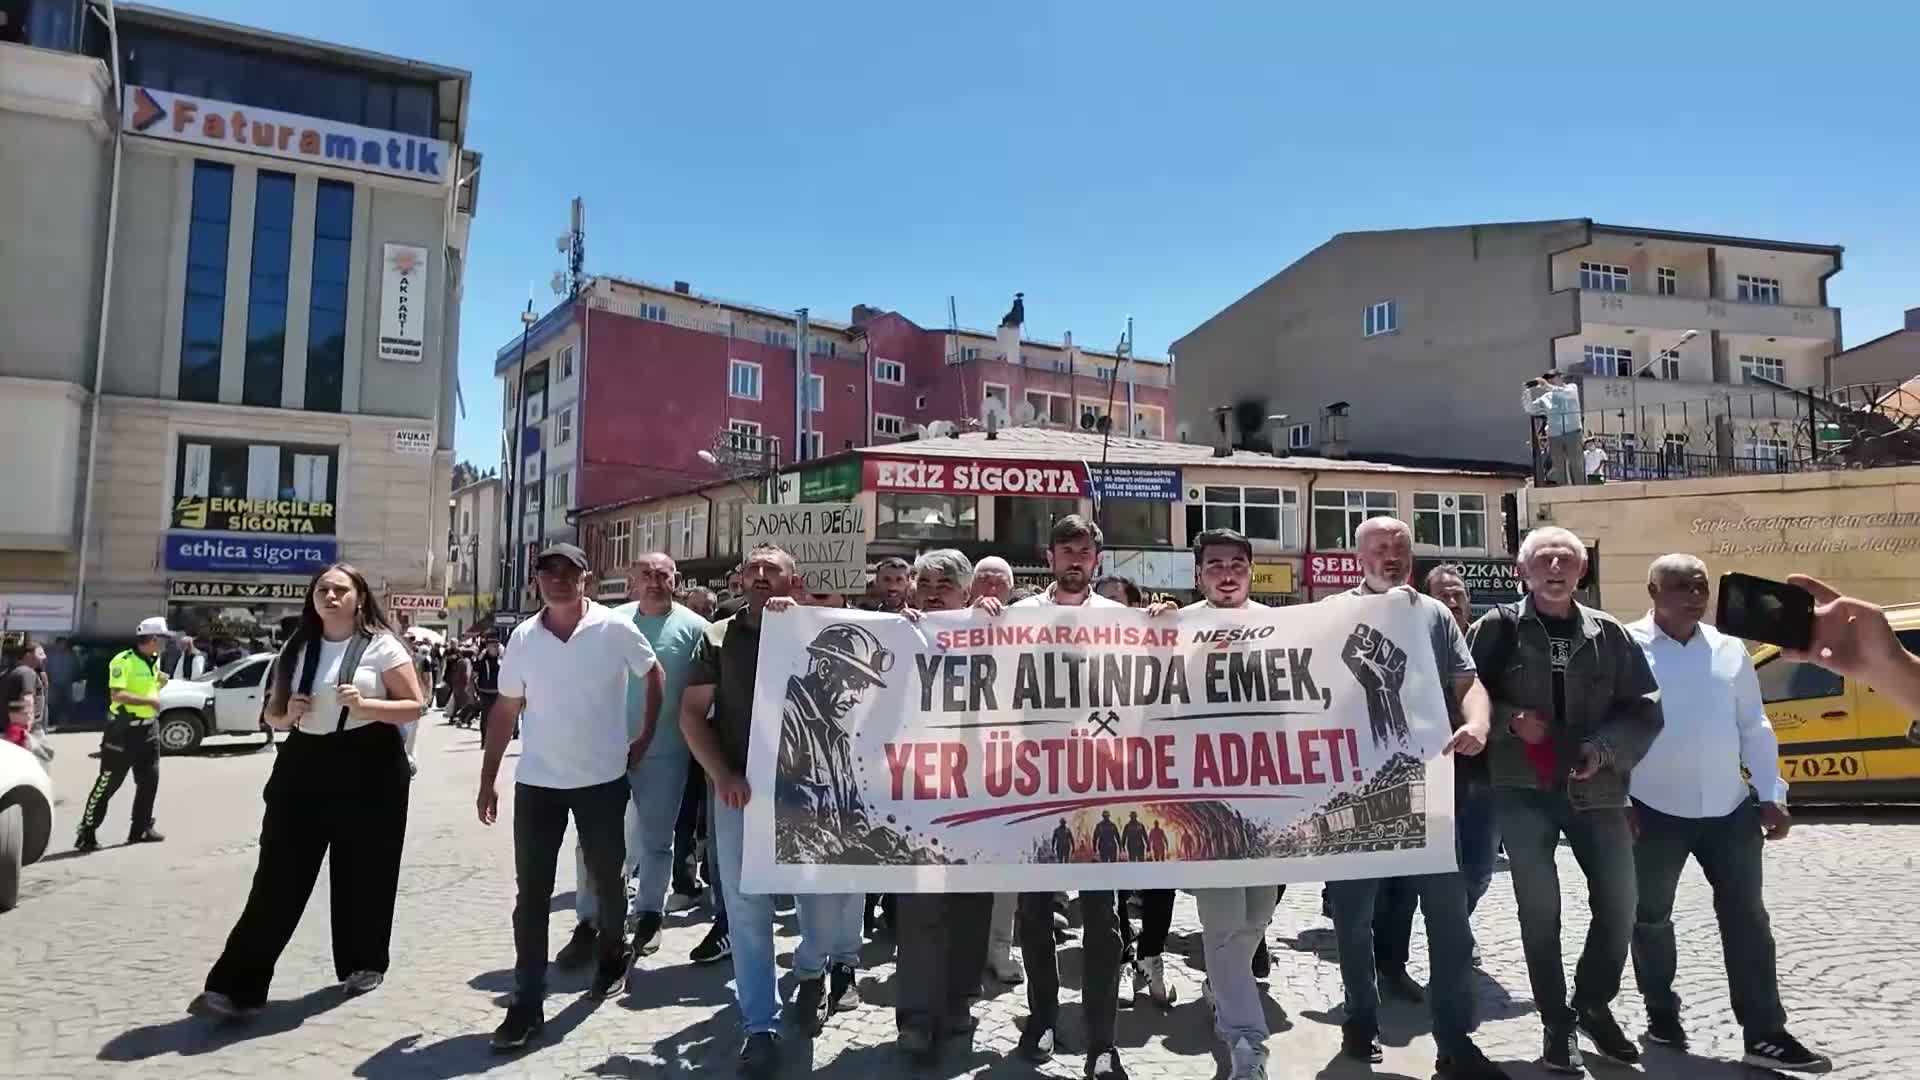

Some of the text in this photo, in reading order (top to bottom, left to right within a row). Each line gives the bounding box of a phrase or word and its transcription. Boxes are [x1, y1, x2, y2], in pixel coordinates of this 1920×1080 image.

[171, 98, 440, 176] Faturamatik
[877, 460, 944, 488] EKİZ
[953, 462, 1079, 493] SİGORTA
[210, 497, 333, 517] EKMEKÇİLER
[228, 514, 314, 533] SİGORTA
[745, 511, 812, 537] SADAKA
[180, 540, 322, 565] ethica sigorta
[174, 582, 233, 596] KASAP
[393, 597, 442, 608] ECZANE
[936, 623, 1179, 653] ŞEBİNKARAHİSAR
[915, 648, 1332, 712] YER ALTINDA EMEK,
[884, 728, 1363, 801] YER ÜSTÜNDE ADALET!
[1784, 756, 1859, 778] 7020
